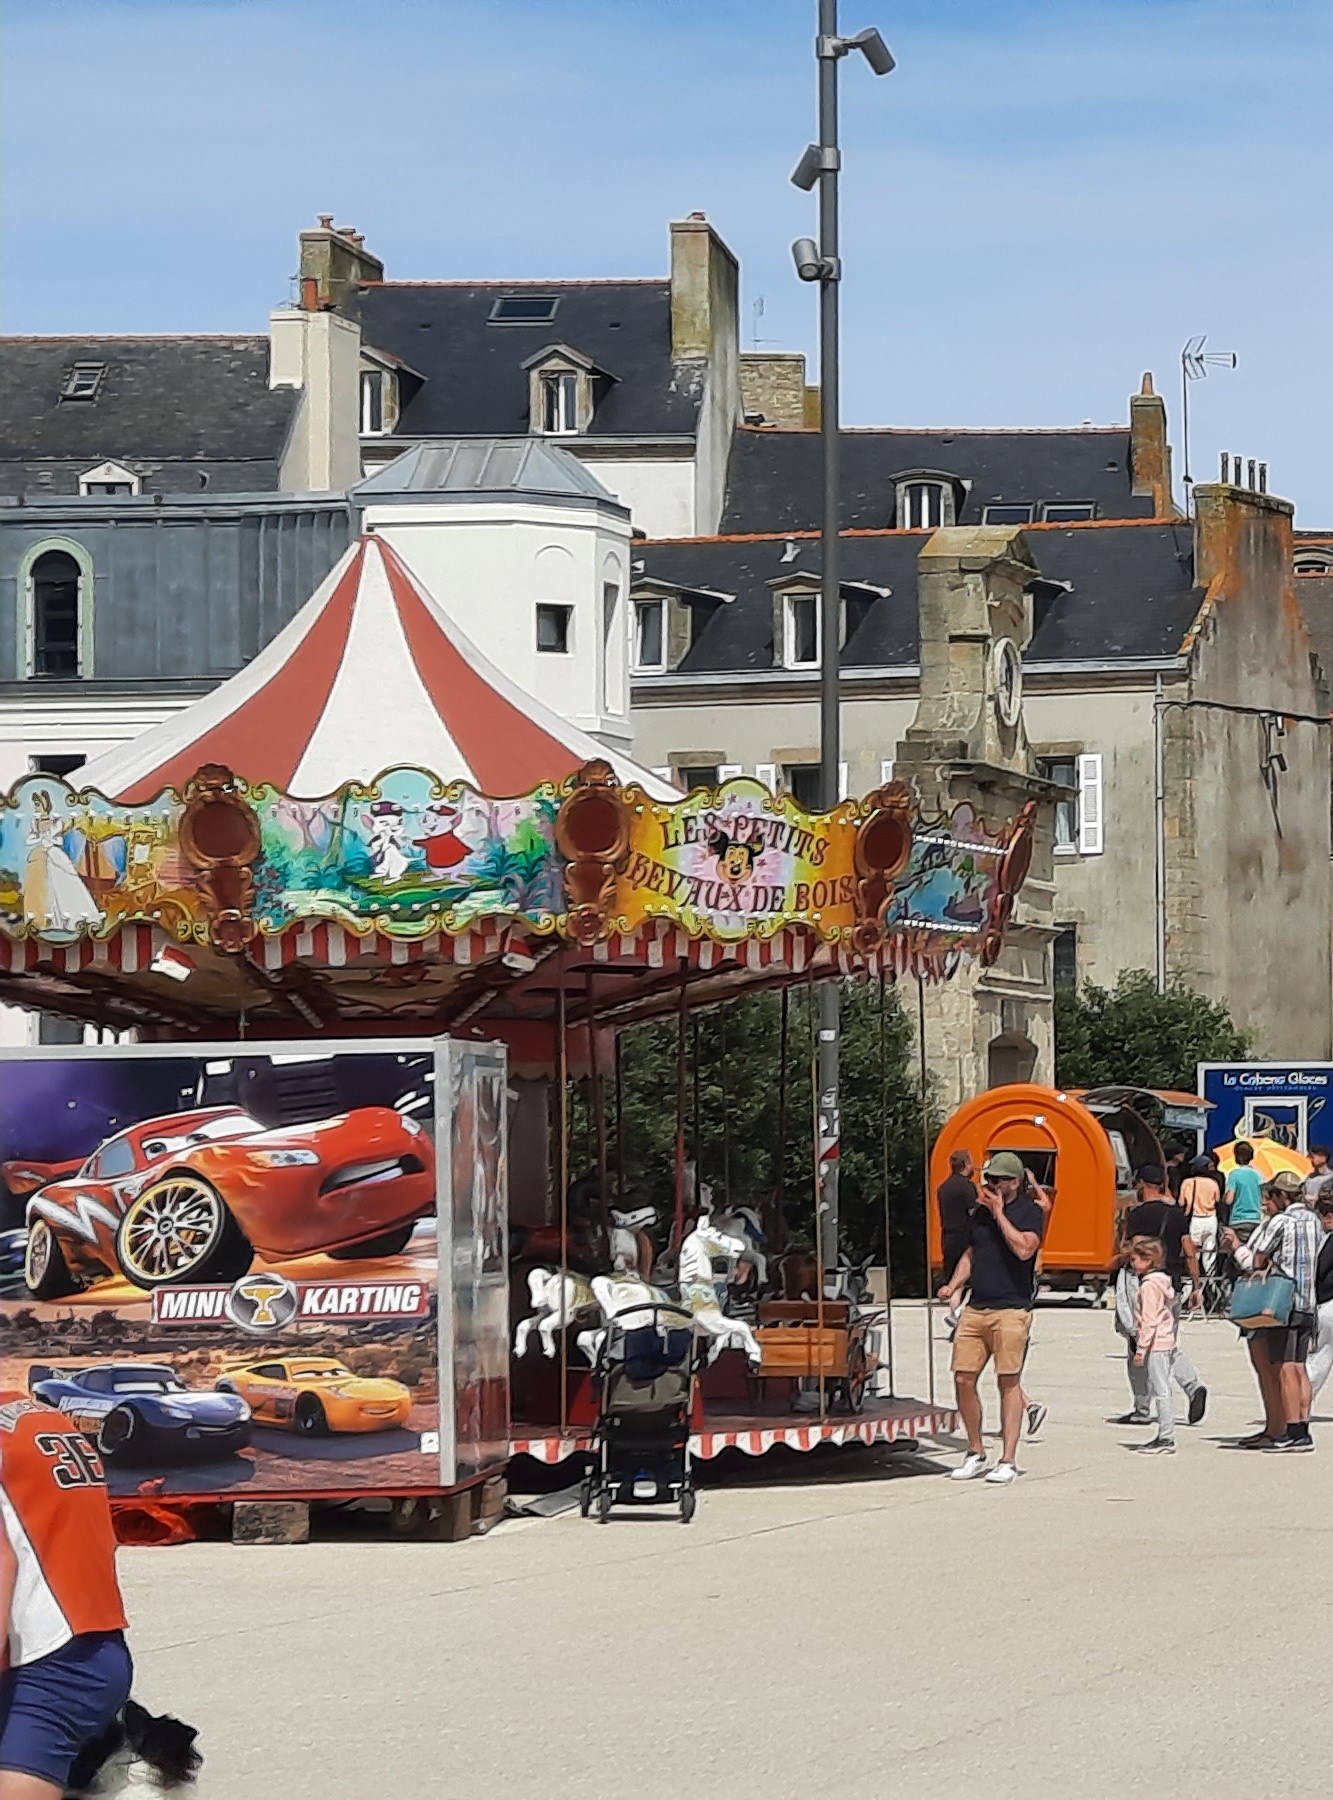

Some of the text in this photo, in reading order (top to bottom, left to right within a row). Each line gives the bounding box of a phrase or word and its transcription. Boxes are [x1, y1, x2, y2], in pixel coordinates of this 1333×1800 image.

[659, 812, 831, 867] LES PETITS
[625, 852, 855, 914] HEVAUX DE BOIS
[159, 1284, 422, 1319] MINI KARTING
